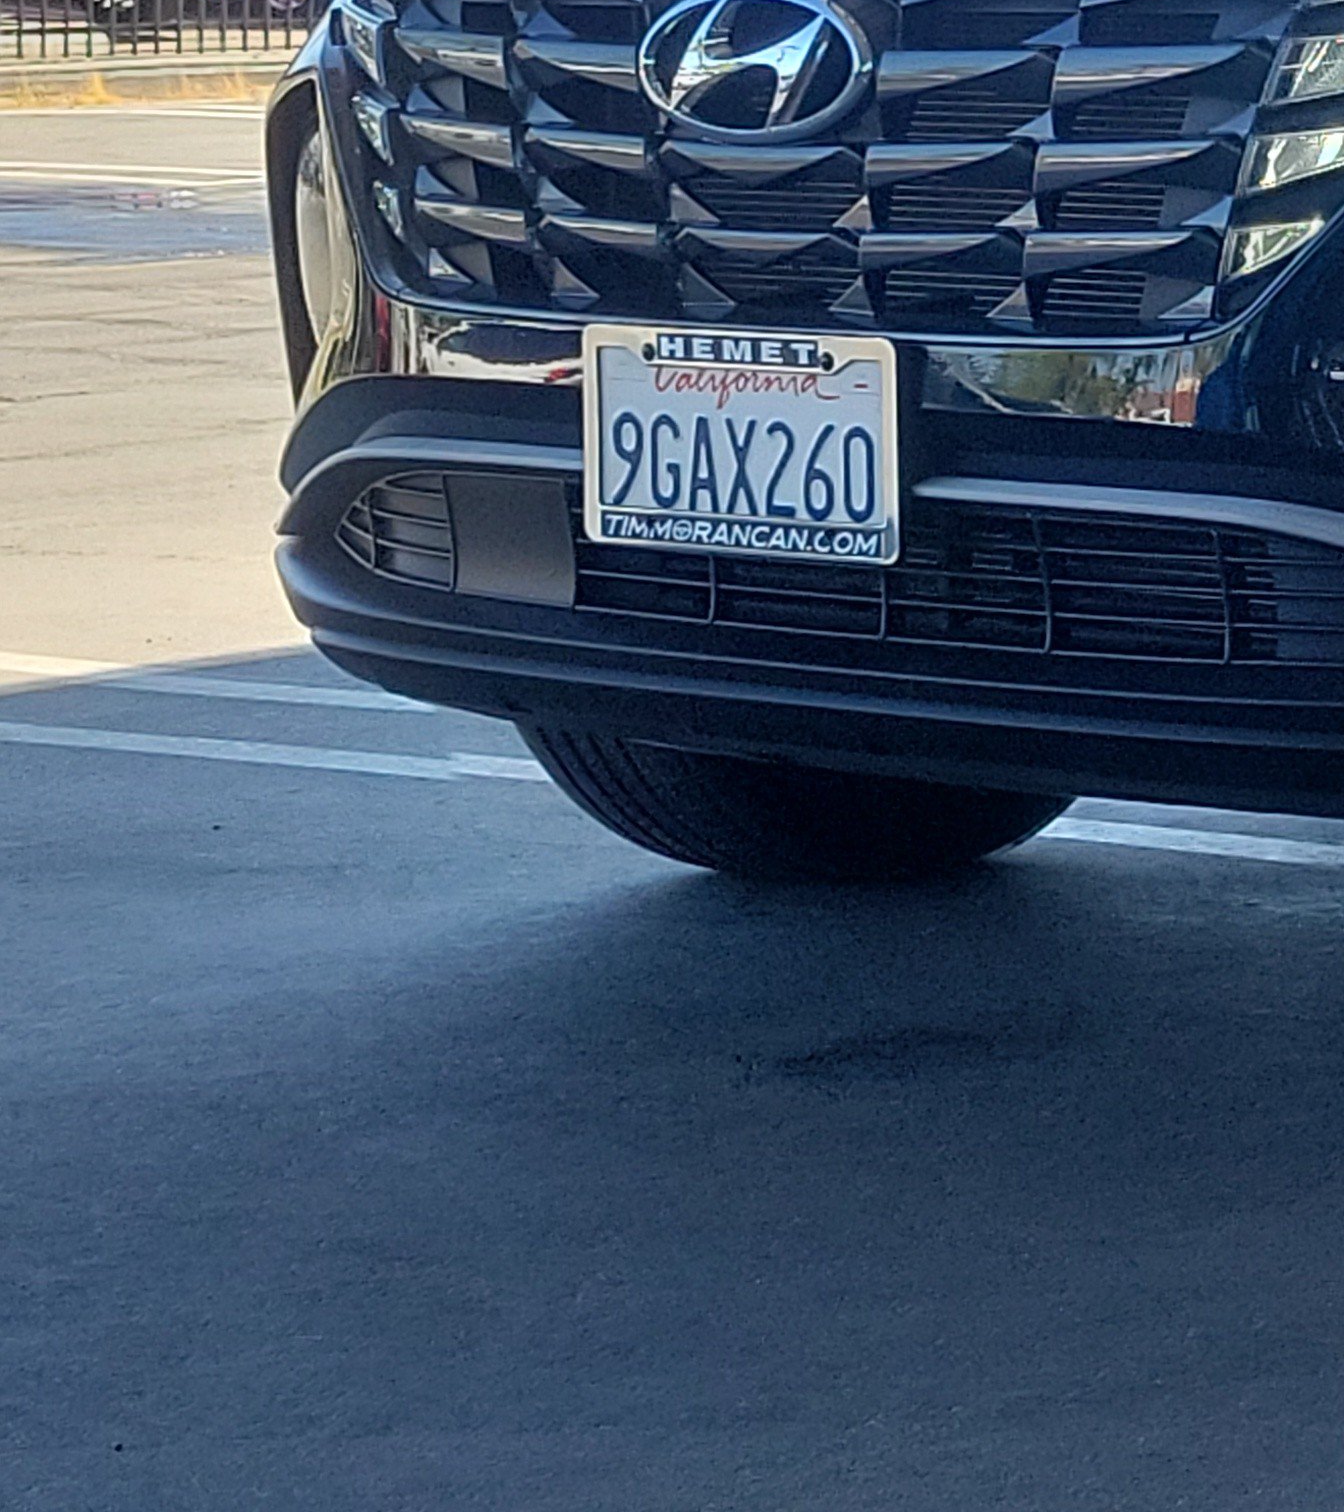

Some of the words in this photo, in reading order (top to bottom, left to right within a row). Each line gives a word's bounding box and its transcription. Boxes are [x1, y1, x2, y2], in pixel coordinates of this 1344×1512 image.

[660, 336, 815, 364] HEMET
[655, 366, 841, 409] California
[612, 411, 875, 524] 9GAX260
[605, 514, 878, 555] TIMMORANCAN.COM
